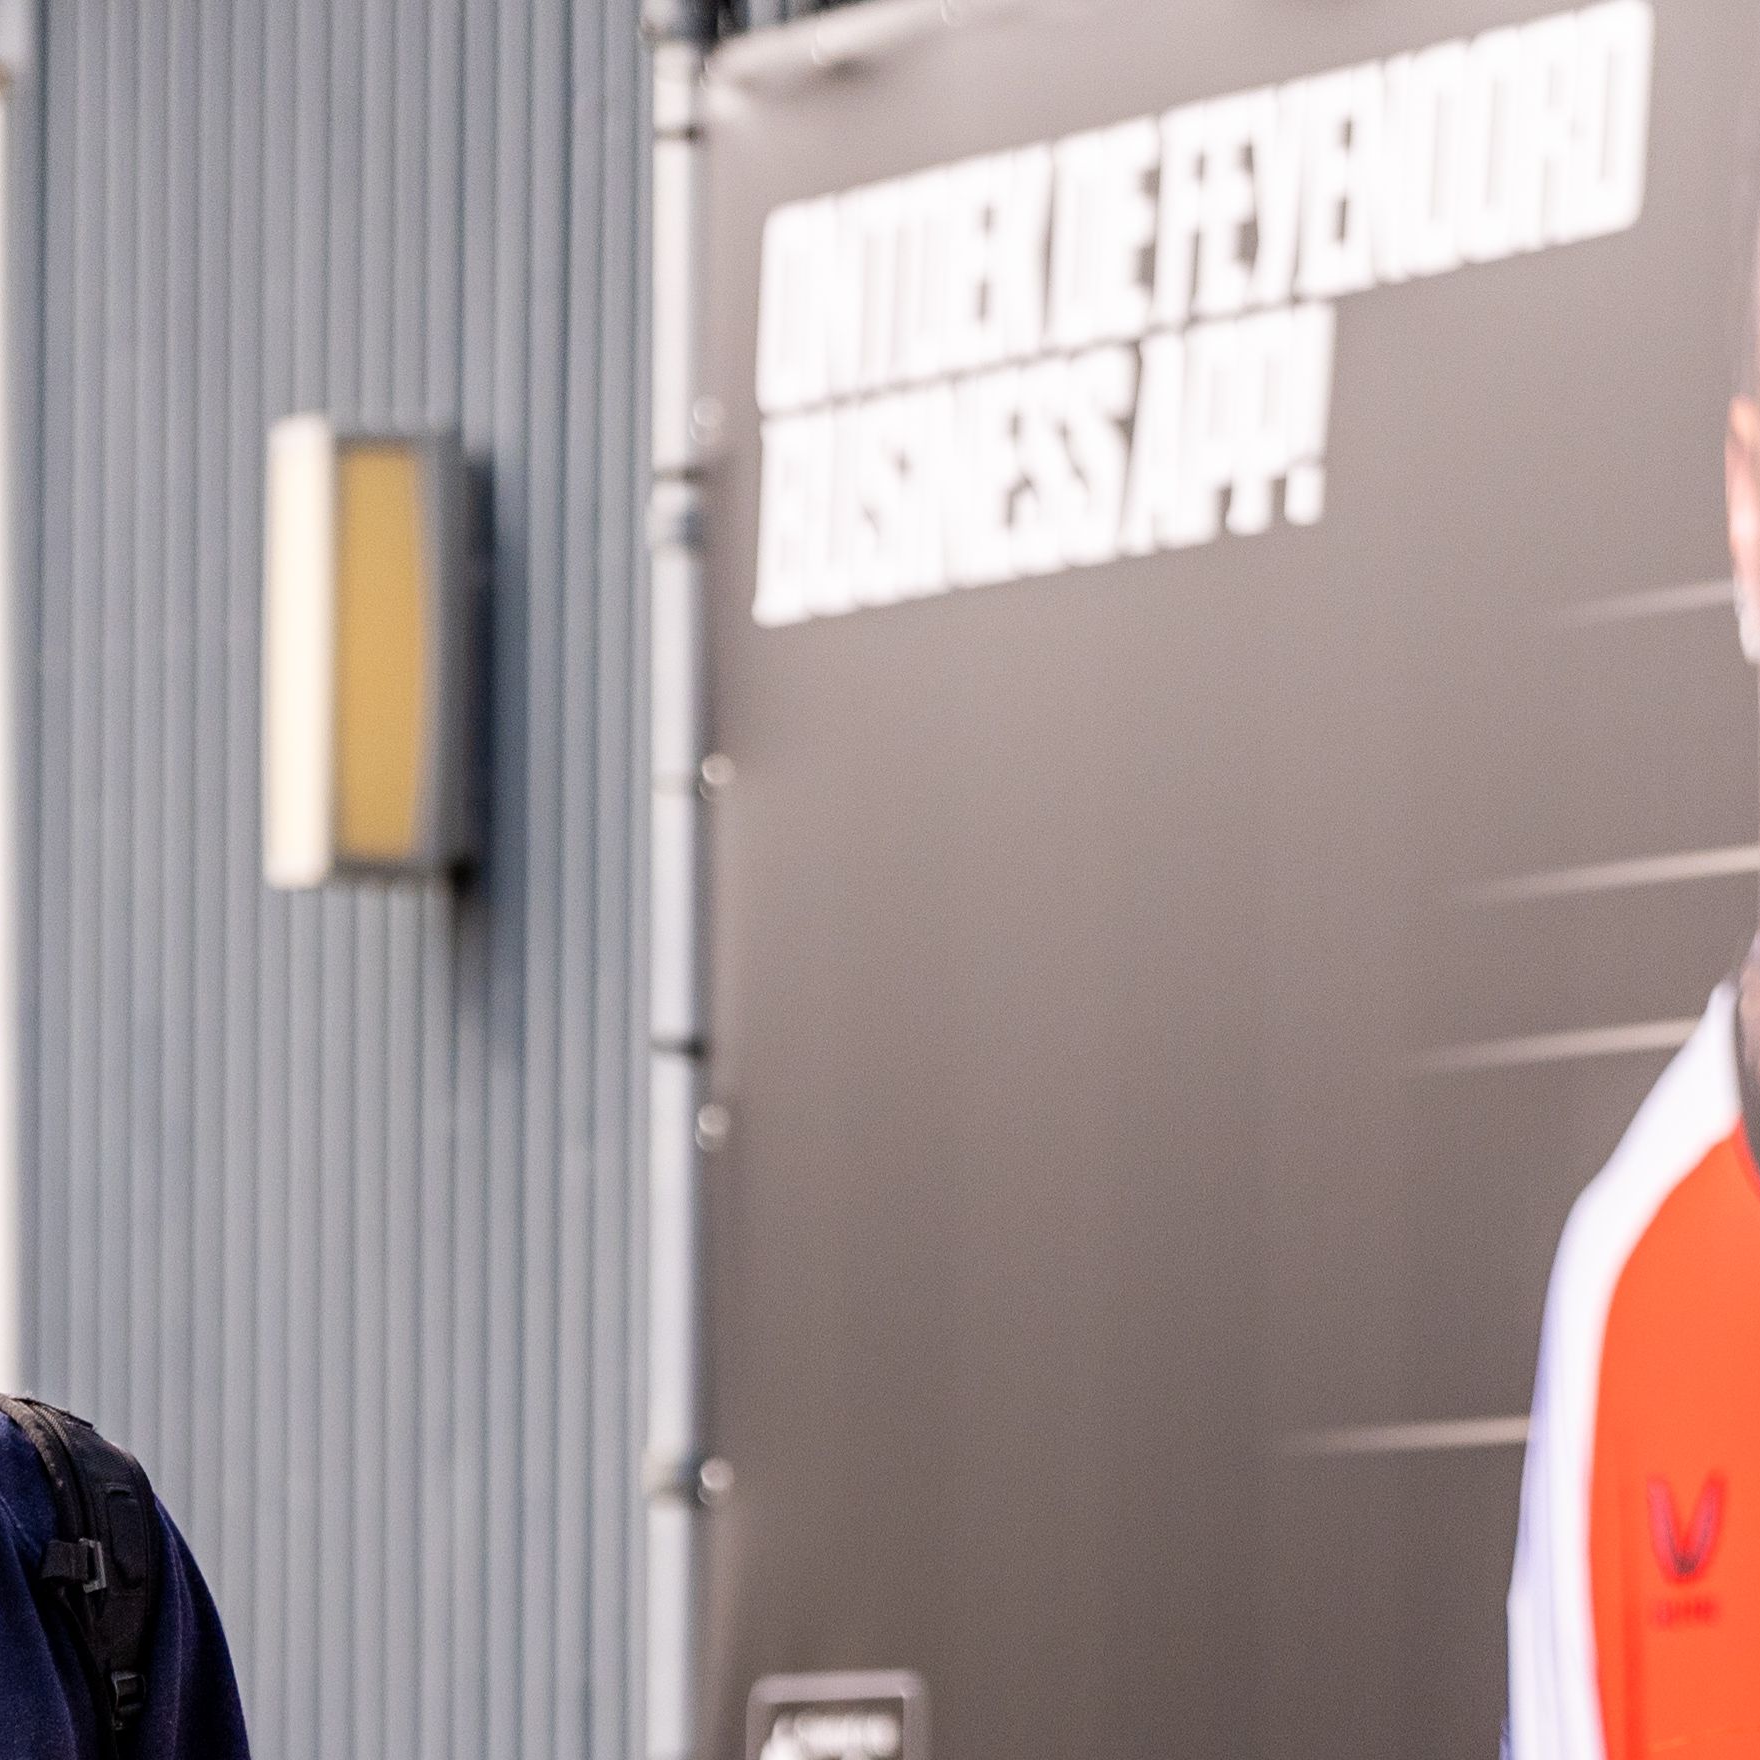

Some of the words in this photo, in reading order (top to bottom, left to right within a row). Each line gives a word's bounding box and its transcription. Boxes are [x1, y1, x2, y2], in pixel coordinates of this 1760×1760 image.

[758, 146, 1051, 413] ONTDEK
[1044, 116, 1159, 348] DE
[1156, 0, 1651, 324] FEYENOORD
[756, 347, 1134, 624] BUSINESS
[1123, 304, 1331, 554] APP!
